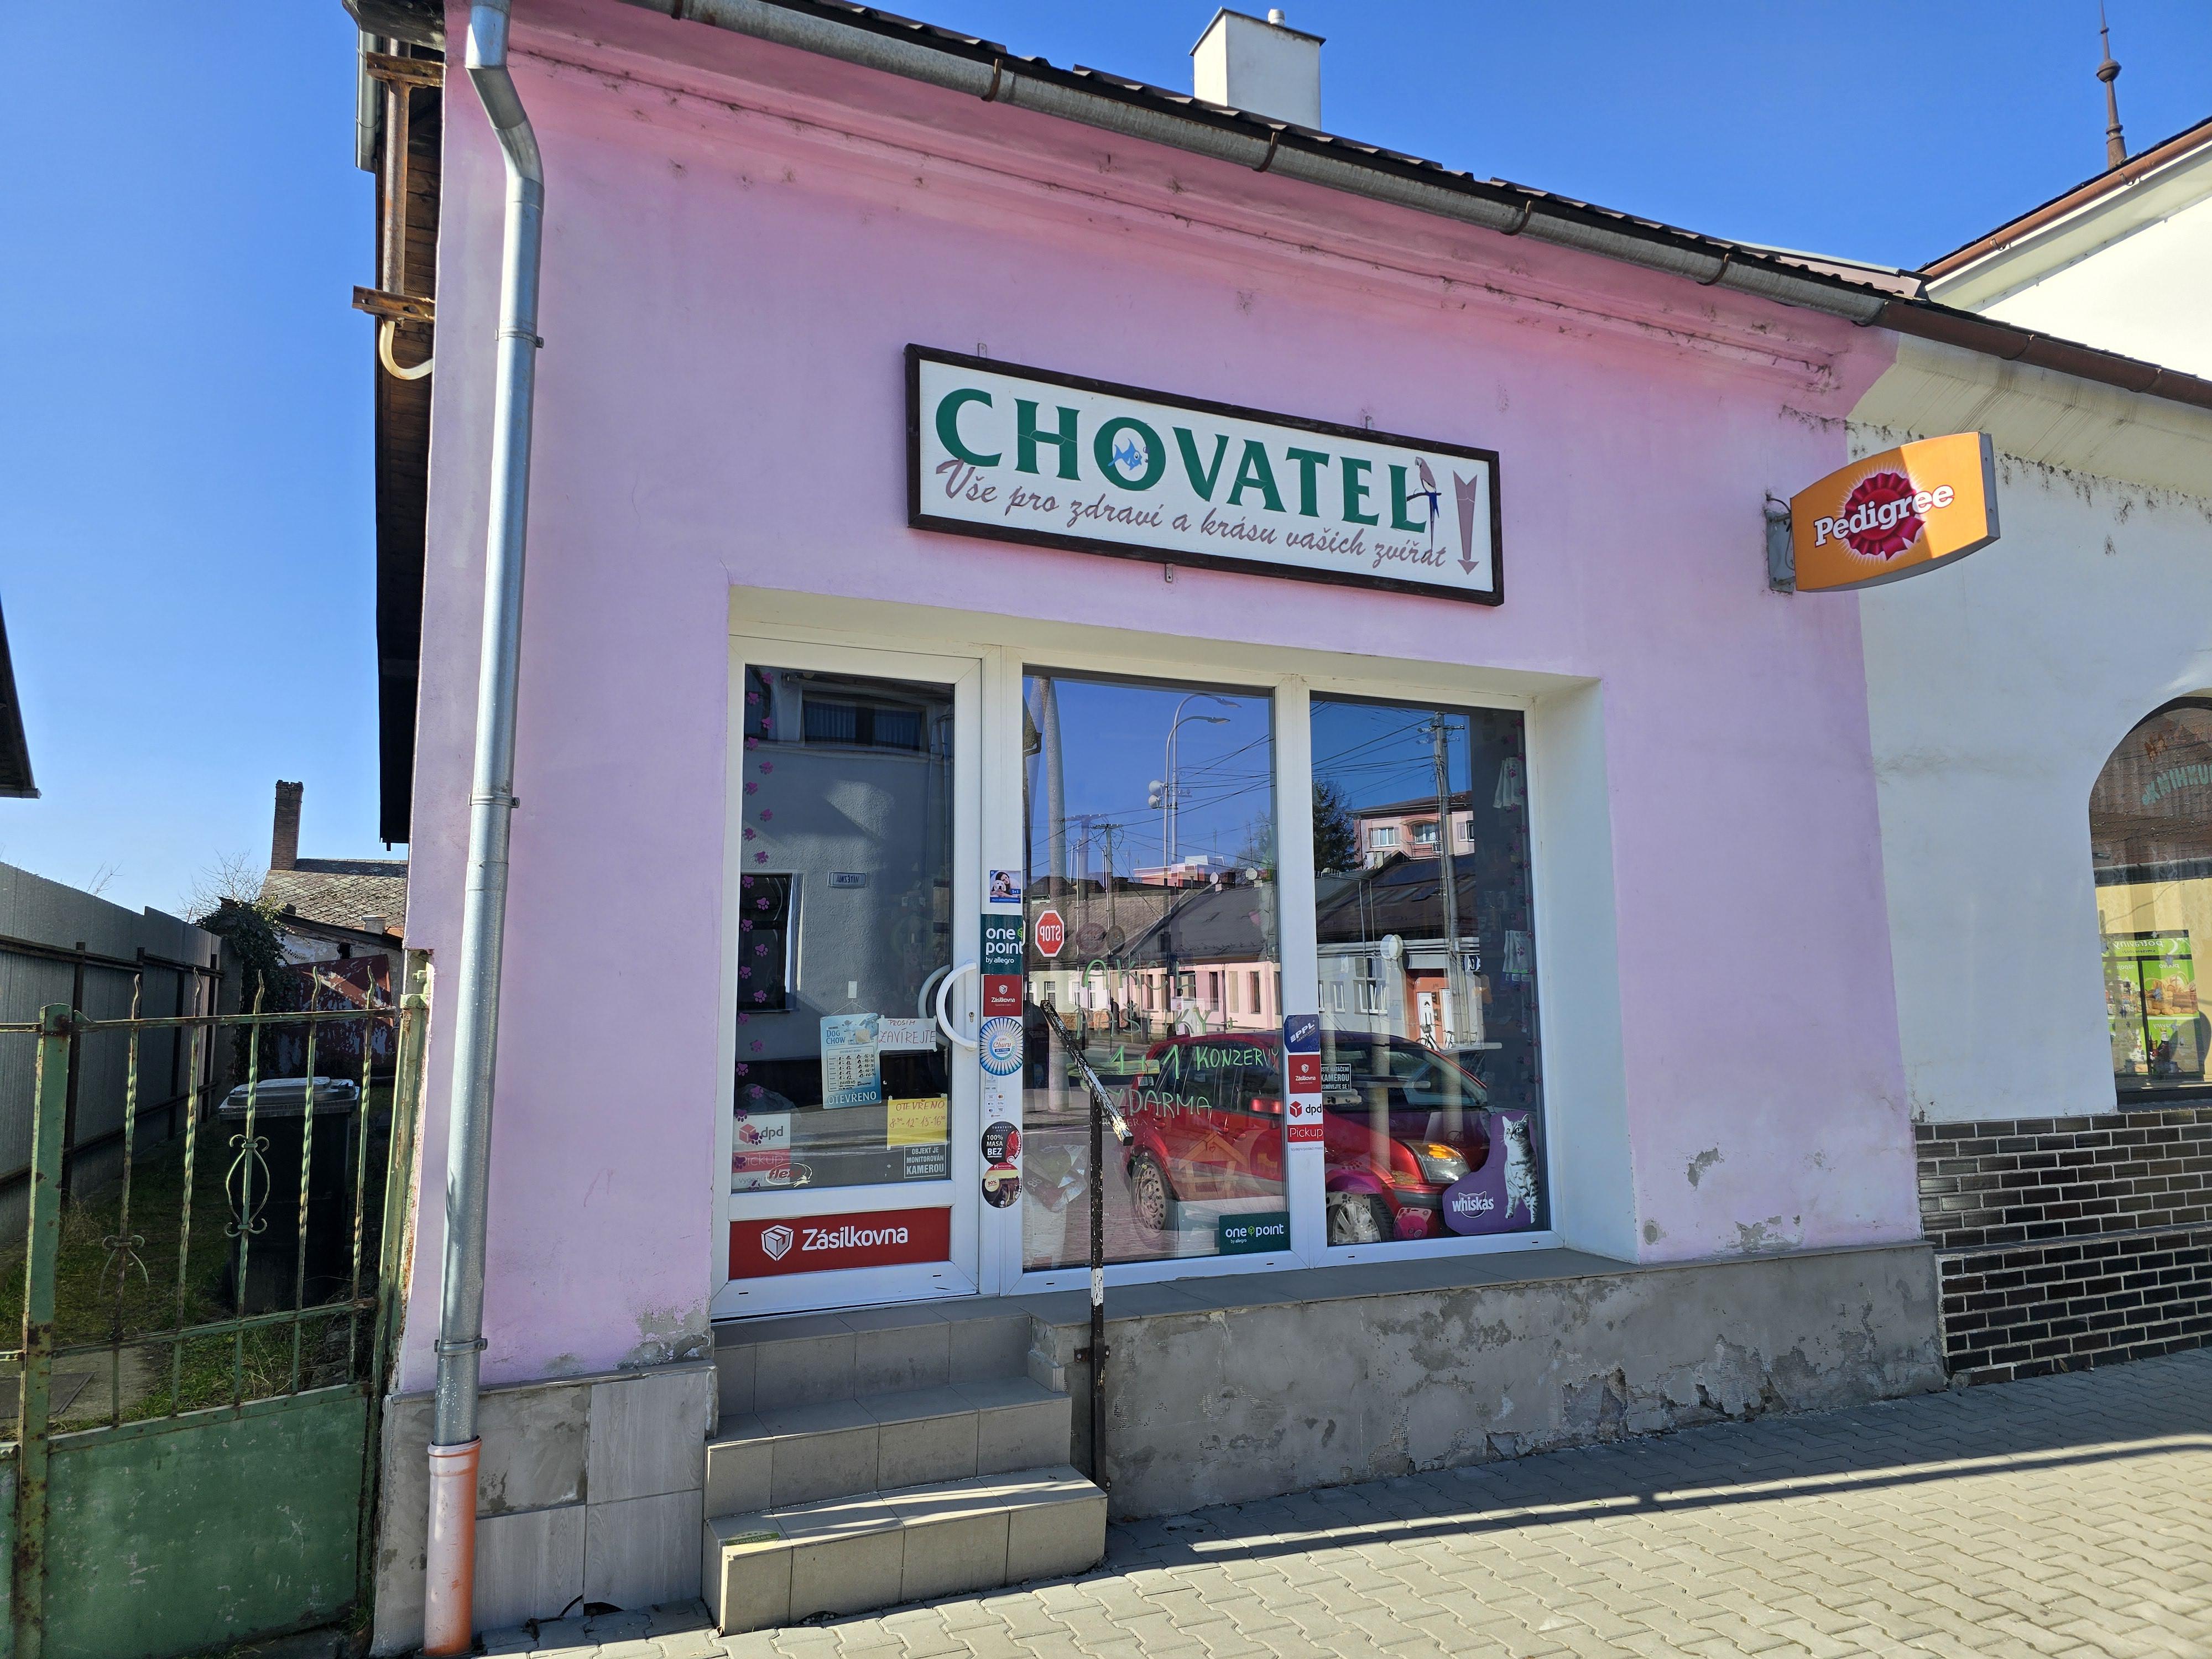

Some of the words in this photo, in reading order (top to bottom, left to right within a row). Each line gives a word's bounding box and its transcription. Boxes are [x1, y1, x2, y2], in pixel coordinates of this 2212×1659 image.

[935, 388, 1428, 533] CHOVATEL
[936, 458, 998, 503] Vše
[1004, 486, 1060, 516] pro
[1066, 493, 1165, 529] zdraví
[1172, 513, 1192, 532] a
[1200, 508, 1277, 544] krásu
[1286, 528, 1366, 555] vašich
[1371, 539, 1447, 568] zvířat
[1814, 483, 1954, 549] Pedigree
[985, 928, 1016, 940] one
[985, 941, 1024, 956] point
[993, 957, 1015, 965] allegro
[879, 1027, 937, 1044] ZAVÍREJTE
[1295, 1022, 1315, 1038] PPL
[826, 1036, 846, 1045] CHOW
[828, 1091, 877, 1104] OTEVŘENO
[896, 1099, 945, 1112] OTEVŘENO
[1306, 1104, 1322, 1115] dpd
[761, 1125, 784, 1140] dpd
[1290, 1128, 1323, 1139] Pickup
[906, 1155, 944, 1164] MONITOROVÁN
[906, 1164, 944, 1175] KAMEROU
[1452, 1197, 1494, 1212] whiskas
[802, 1225, 908, 1251] Zásilkovna
[1225, 1228, 1246, 1238] one
[1255, 1224, 1284, 1238] point
